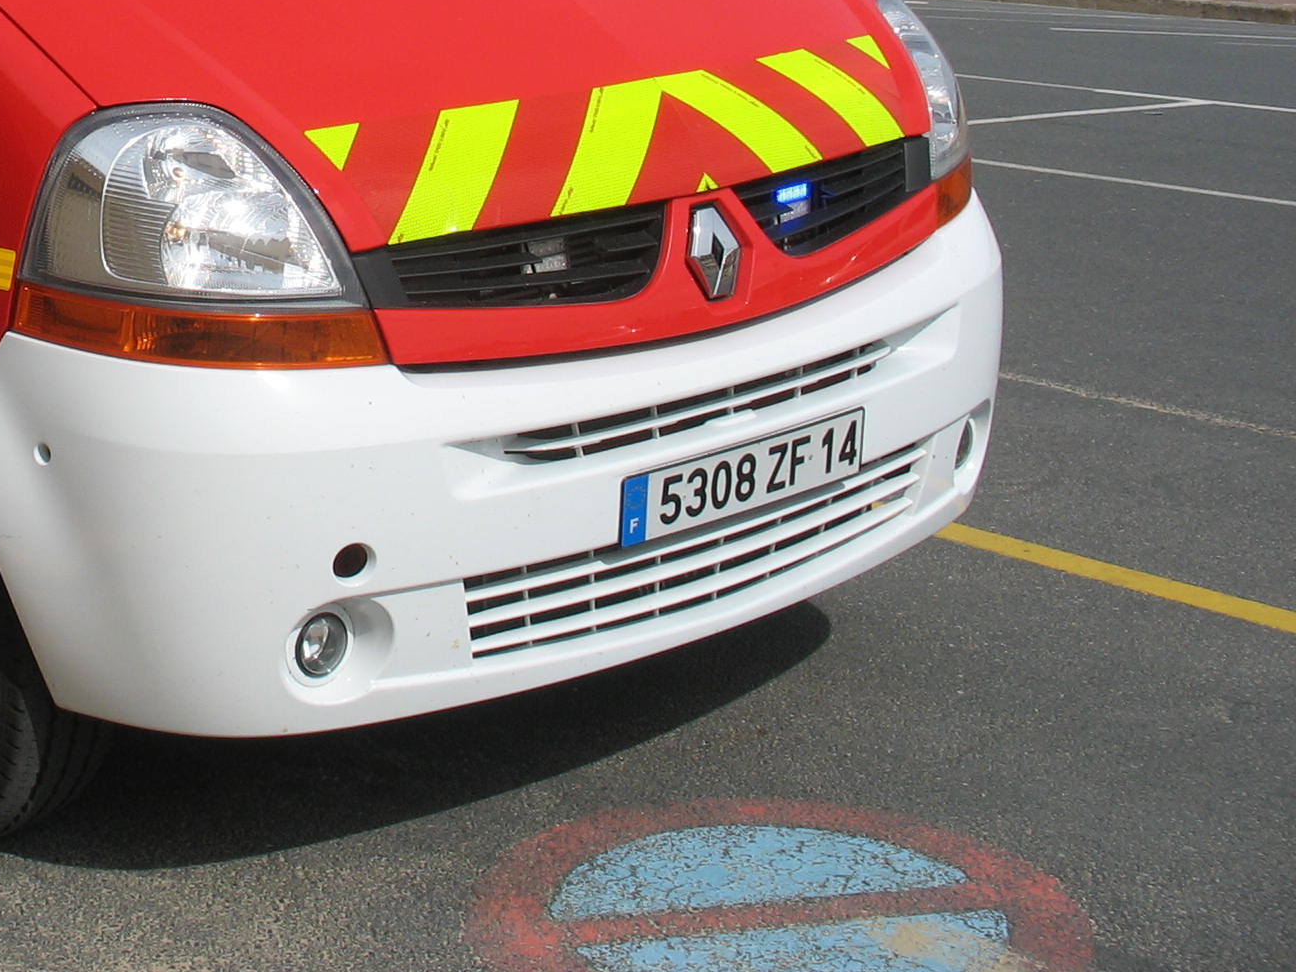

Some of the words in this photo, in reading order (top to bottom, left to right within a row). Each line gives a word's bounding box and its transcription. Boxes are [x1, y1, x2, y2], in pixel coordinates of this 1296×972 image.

[659, 452, 757, 525] 5308
[766, 434, 812, 494] ZF
[821, 419, 858, 474] 14
[630, 517, 640, 534] F
